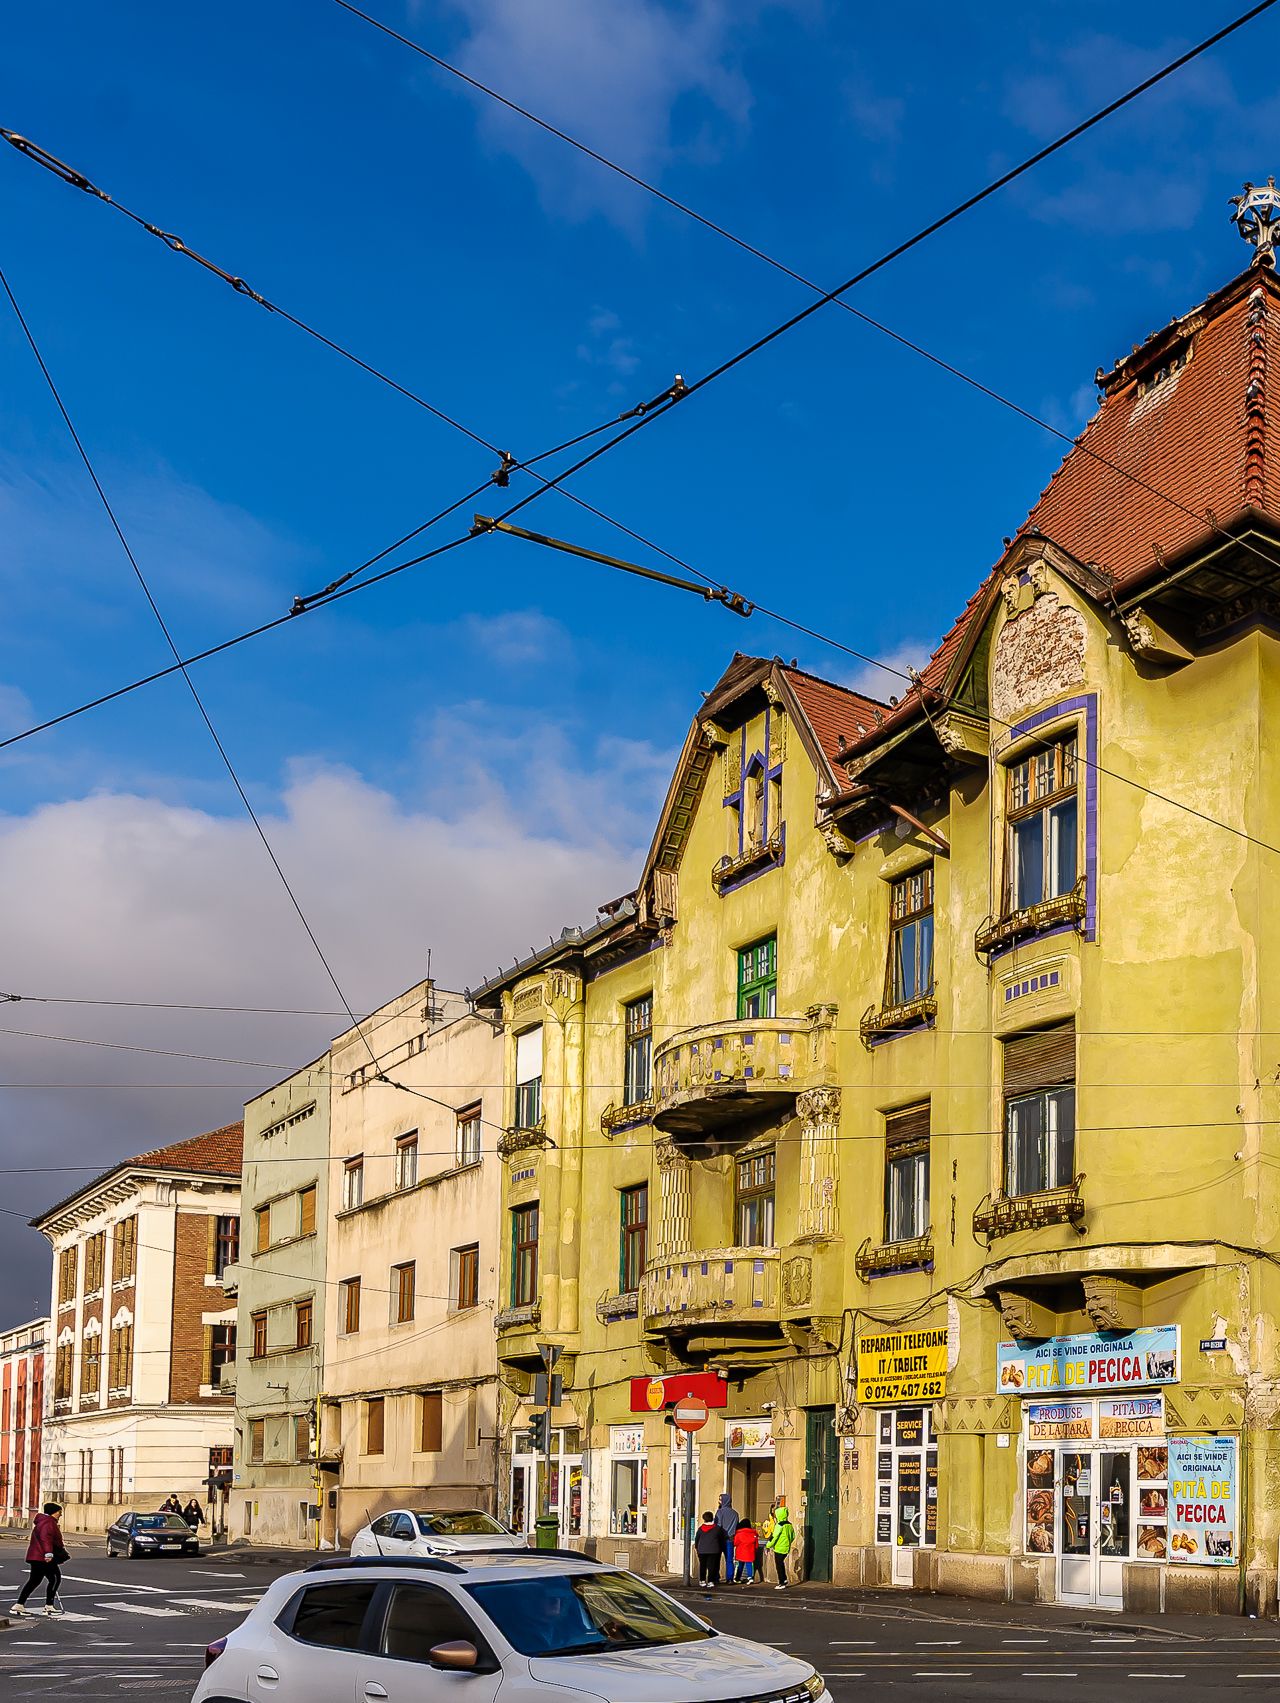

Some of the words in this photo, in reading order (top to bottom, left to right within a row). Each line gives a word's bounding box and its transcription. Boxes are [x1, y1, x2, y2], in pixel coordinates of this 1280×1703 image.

[861, 1335, 901, 1355] REPARAȚII
[904, 1330, 948, 1350] TELEFOANE
[1036, 1349, 1050, 1358] AICI
[1053, 1348, 1062, 1356] SE
[1065, 1345, 1087, 1355] VINDE
[1090, 1341, 1133, 1353] ORIGINALA
[879, 1359, 886, 1374] IT
[894, 1355, 928, 1373] TABLETE
[1027, 1359, 1060, 1387] PITĂ
[1064, 1361, 1085, 1385] DE
[1089, 1357, 1142, 1383] PECICA
[875, 1385, 899, 1398] 0747
[901, 1383, 920, 1396] 407
[922, 1381, 941, 1395] 682
[1039, 1407, 1082, 1420] PRODUSE
[1138, 1403, 1154, 1414] DE
[897, 1420, 922, 1430] SERVICE
[1034, 1424, 1046, 1436] DE
[1049, 1423, 1060, 1435] LA
[1116, 1420, 1153, 1433] PECICA
[903, 1431, 916, 1439] GSM
[1173, 1477, 1207, 1499] PITĂ
[1211, 1481, 1230, 1499] DE
[1176, 1504, 1226, 1523] PECICA
